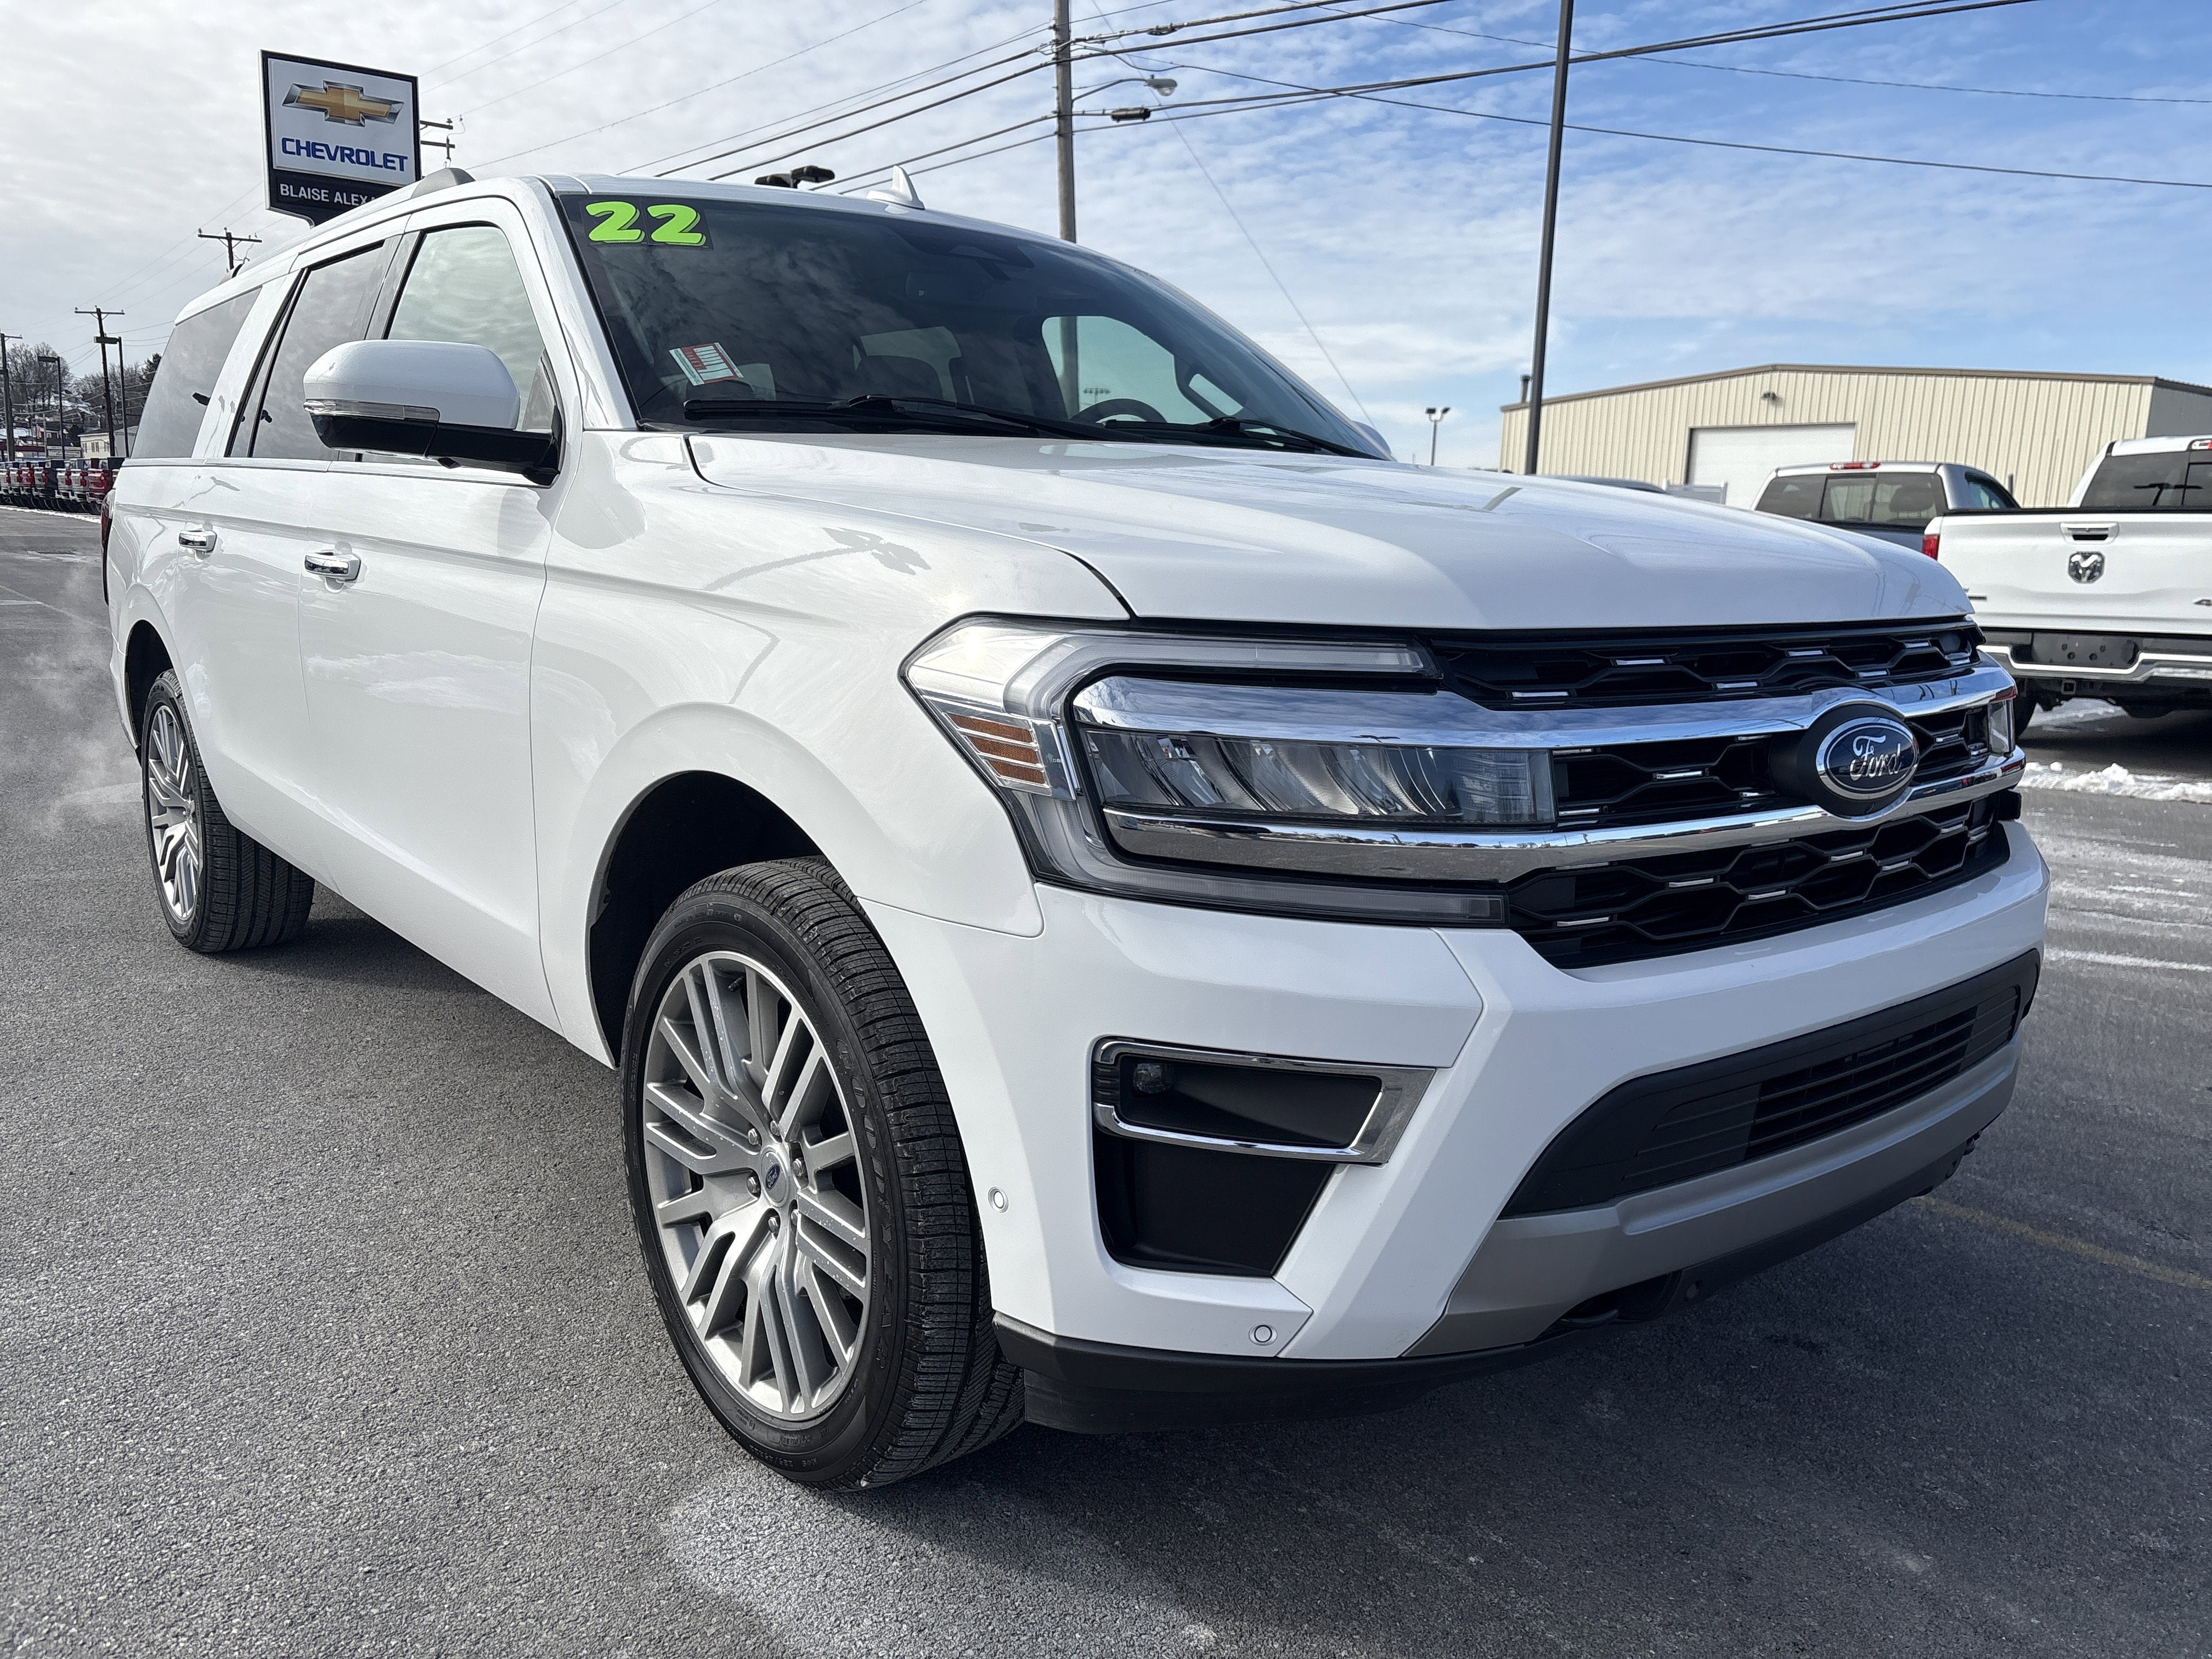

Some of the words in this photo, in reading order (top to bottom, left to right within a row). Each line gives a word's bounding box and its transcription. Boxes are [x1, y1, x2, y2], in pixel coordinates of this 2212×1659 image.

[281, 137, 408, 172] CHEVROLET
[280, 183, 330, 202] BLAISE
[334, 191, 375, 206] ALEX
[585, 201, 707, 246] 22
[1849, 735, 1902, 781] Ford
